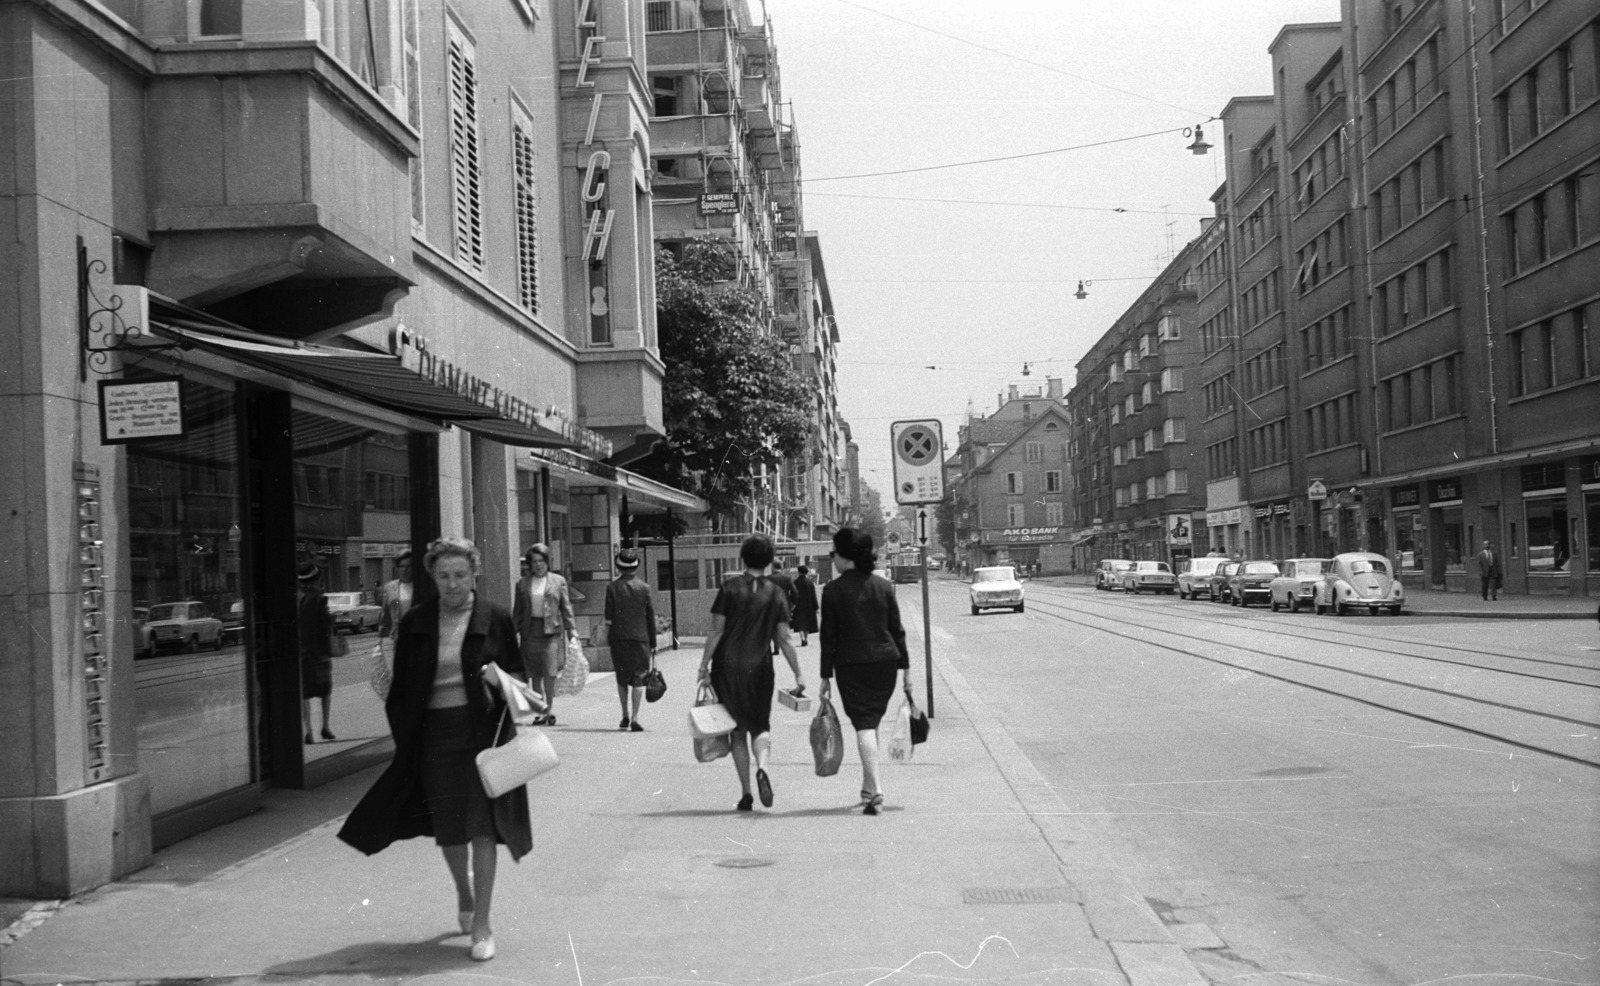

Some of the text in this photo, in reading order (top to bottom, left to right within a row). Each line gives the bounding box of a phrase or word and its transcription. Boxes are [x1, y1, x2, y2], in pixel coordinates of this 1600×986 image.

[701, 200, 736, 210] Spenglerei
[418, 350, 492, 407] DIAMANT
[1178, 527, 1186, 537] P
